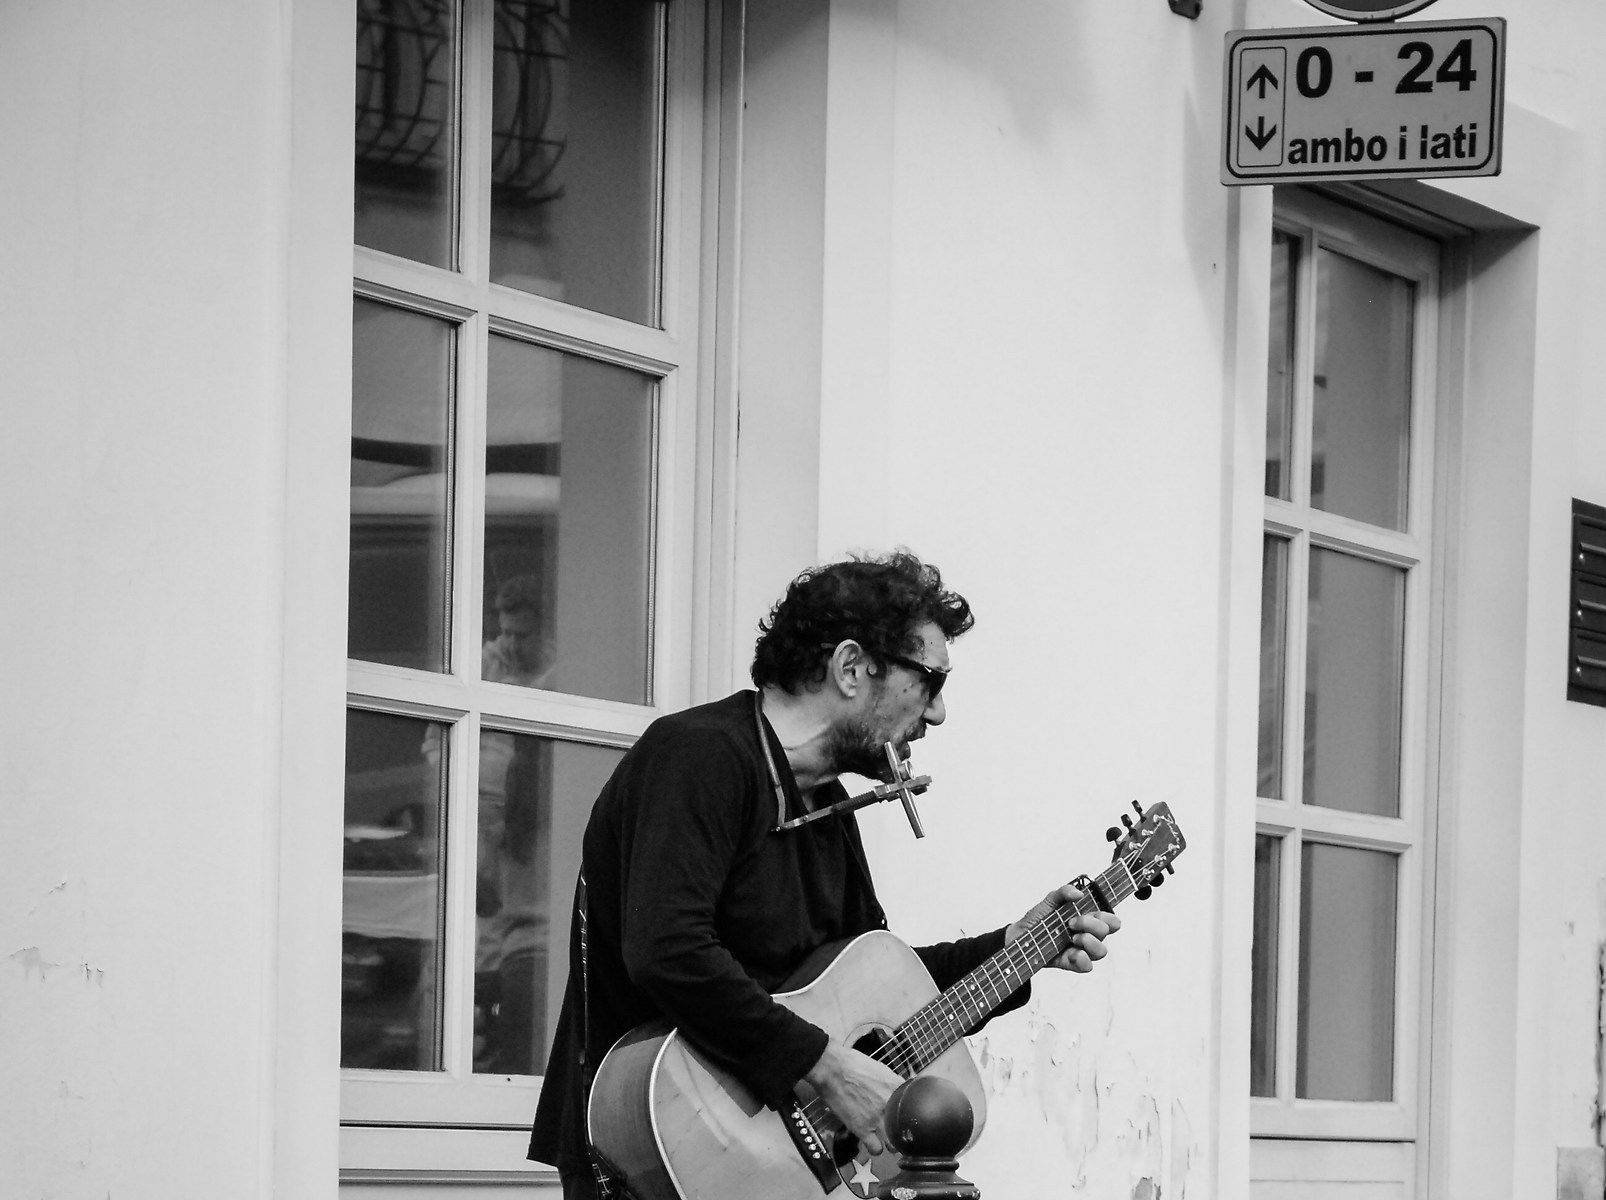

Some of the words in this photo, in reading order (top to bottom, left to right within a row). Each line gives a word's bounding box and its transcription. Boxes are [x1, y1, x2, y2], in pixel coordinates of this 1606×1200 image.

[1295, 45, 1333, 99] 0
[1354, 70, 1375, 83] -
[1394, 38, 1477, 95] 24
[1287, 127, 1388, 165] ambo
[1398, 125, 1408, 161] i
[1419, 122, 1478, 160] lati
